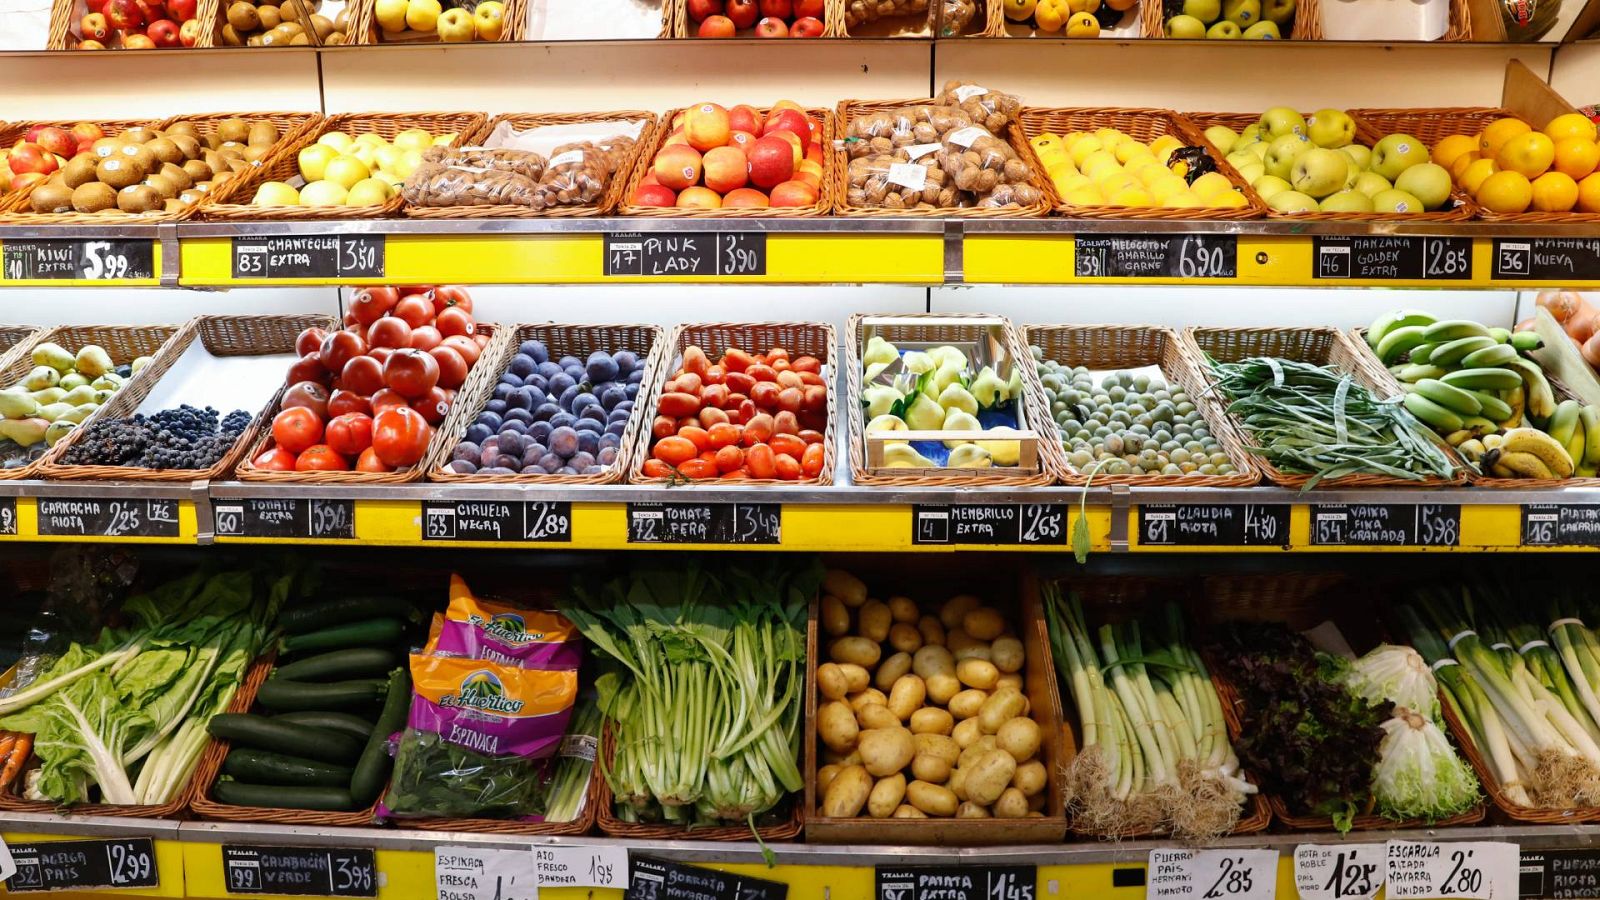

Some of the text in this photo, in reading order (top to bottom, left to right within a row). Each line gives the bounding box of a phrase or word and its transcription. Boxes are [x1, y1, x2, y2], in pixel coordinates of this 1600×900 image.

[239, 254, 262, 272] 83
[270, 253, 311, 266] EXTRA
[612, 250, 636, 269] 17
[1322, 254, 1339, 273] 46
[1358, 250, 1400, 264] GOLDEN
[1502, 252, 1522, 270] 36
[38, 263, 74, 272] EXTRA
[653, 257, 700, 275] LADY
[1081, 255, 1099, 276] 39
[1361, 266, 1398, 276] EXTRA
[153, 504, 169, 519] 76
[252, 500, 296, 510] TOMATE
[457, 503, 510, 517] CIRUELA
[260, 511, 293, 520] EXTRA
[665, 507, 711, 519] TOMATE
[951, 507, 1013, 520] MEMBRILLO
[1177, 507, 1232, 519] CLAUDIA
[218, 512, 237, 532] 60
[459, 519, 500, 539] NEGRA
[633, 518, 658, 540] 72
[956, 523, 994, 536] EXTRA
[670, 523, 707, 540] PERA
[1148, 519, 1168, 542] 61
[1320, 519, 1340, 542] 54
[1530, 522, 1553, 541] 16
[457, 688, 525, 713] Huertico
[449, 724, 498, 753] ESPINACA
[1154, 852, 1193, 863] PUERRO
[537, 863, 568, 872] FRESCO
[636, 861, 666, 872] TXALAKA
[234, 869, 254, 887] 99
[265, 872, 312, 882] VERDE
[440, 875, 478, 889] FRESCA
